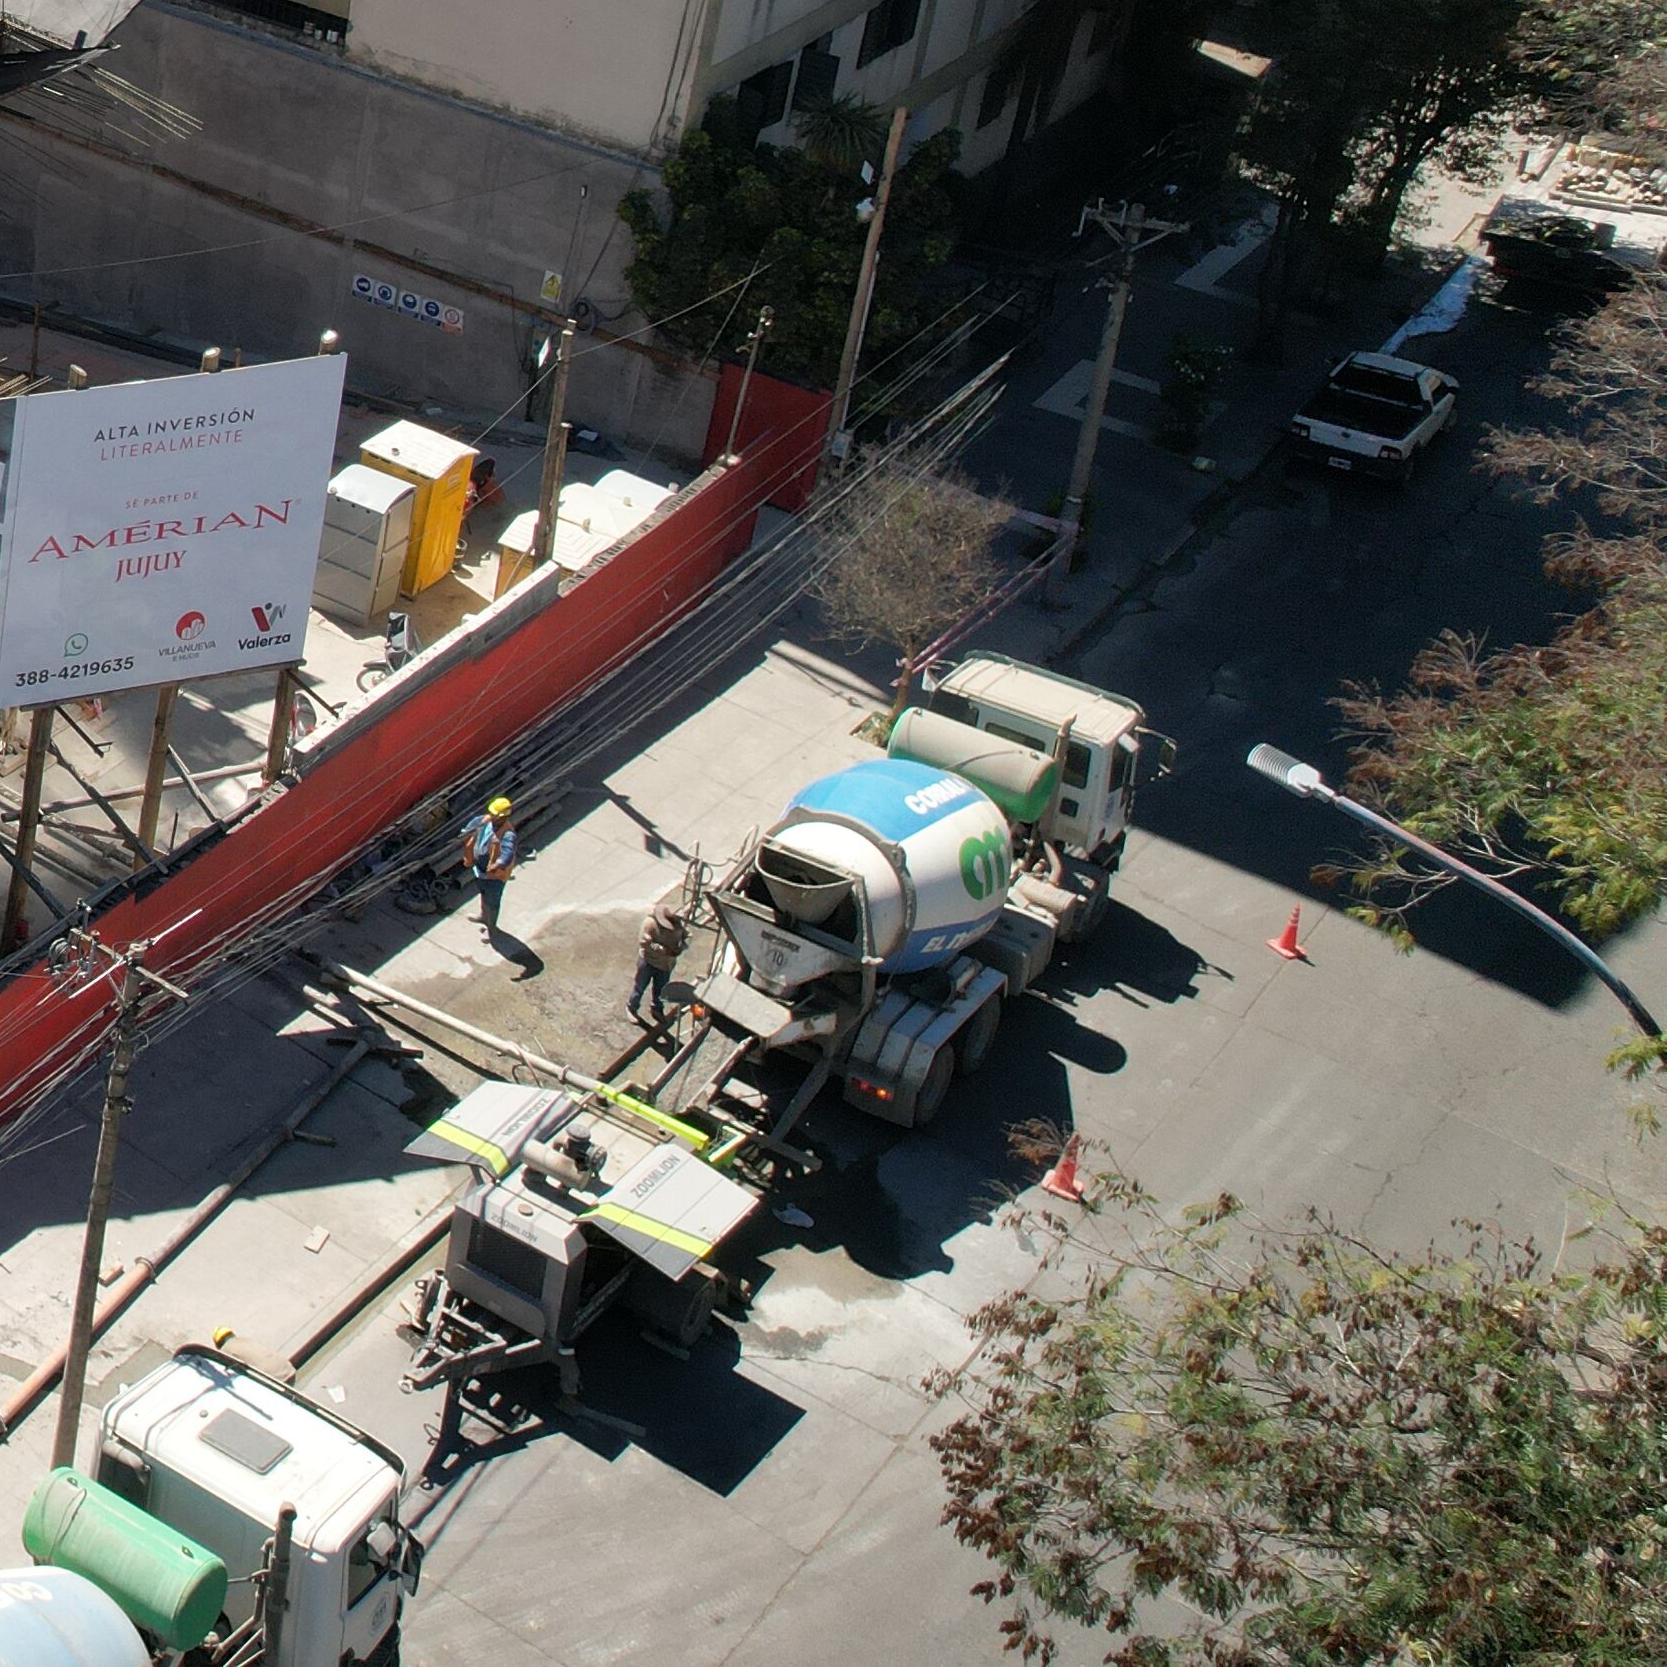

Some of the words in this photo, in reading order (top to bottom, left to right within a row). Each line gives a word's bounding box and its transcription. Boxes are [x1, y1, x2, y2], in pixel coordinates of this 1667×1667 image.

[94, 425, 139, 442] ALTA
[147, 407, 255, 435] INVERSIÓN
[100, 429, 244, 461] LITERALMENTE
[143, 493, 180, 506] PARTE
[184, 490, 199, 500] DE
[28, 499, 292, 563] AMÉRIAN
[115, 550, 187, 582] JUJUY
[158, 640, 216, 656] VILLANUEVA
[238, 633, 291, 650] Valerza
[15, 656, 134, 687] 388-4219635
[630, 1154, 681, 1199] ZOOMLION
